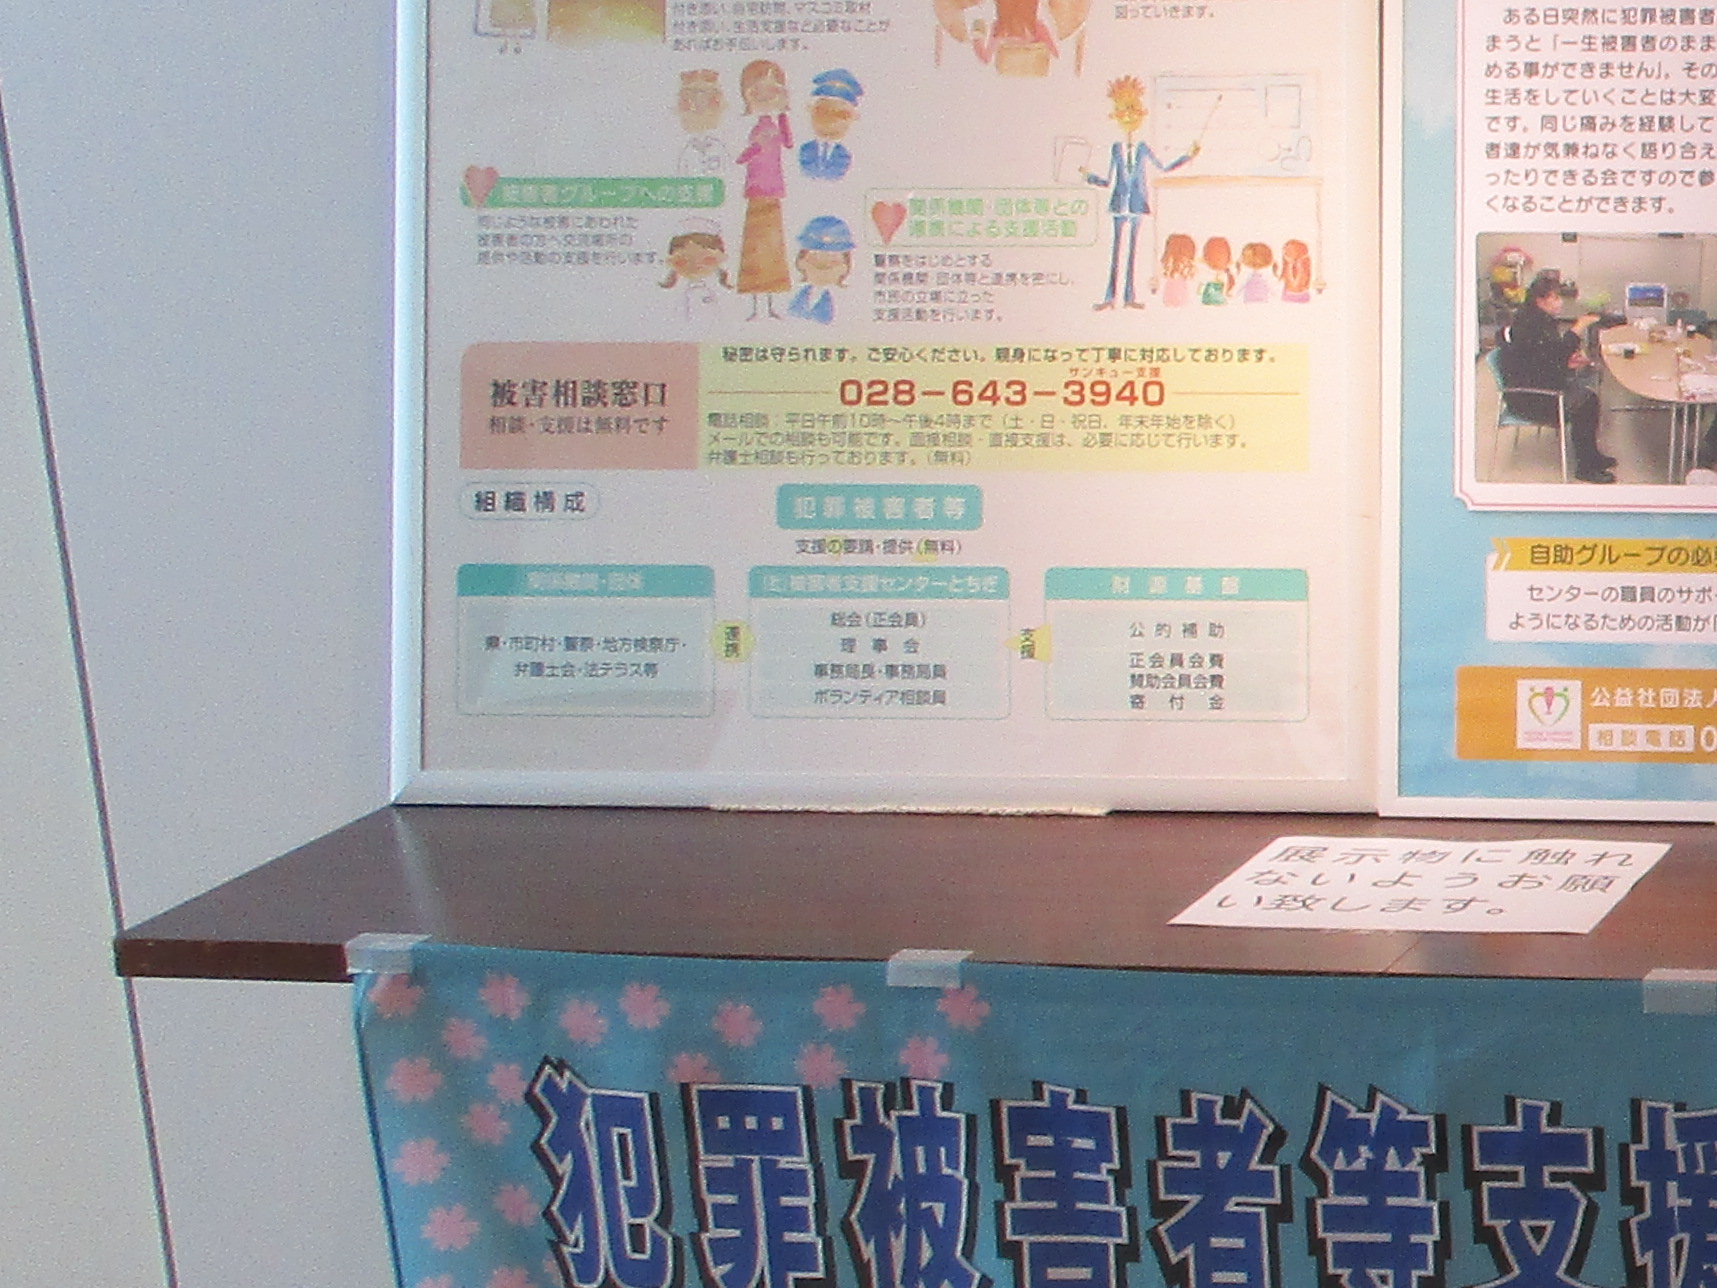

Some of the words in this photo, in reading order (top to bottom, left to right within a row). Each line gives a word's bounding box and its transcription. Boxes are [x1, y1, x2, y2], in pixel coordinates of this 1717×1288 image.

[488, 377, 668, 409] 被害相談窓口
[474, 490, 586, 513] 組織構成
[795, 496, 966, 519] 犯罪被害者等
[1129, 622, 1225, 640] 公的補助
[841, 637, 920, 654] 理事会
[1129, 652, 1225, 669] 正会員会費
[1129, 694, 1225, 711] 寄付金
[1268, 844, 1636, 867] 展示物に触れ
[1244, 868, 1622, 894] ないようお願
[1217, 893, 1508, 915] い致します。
